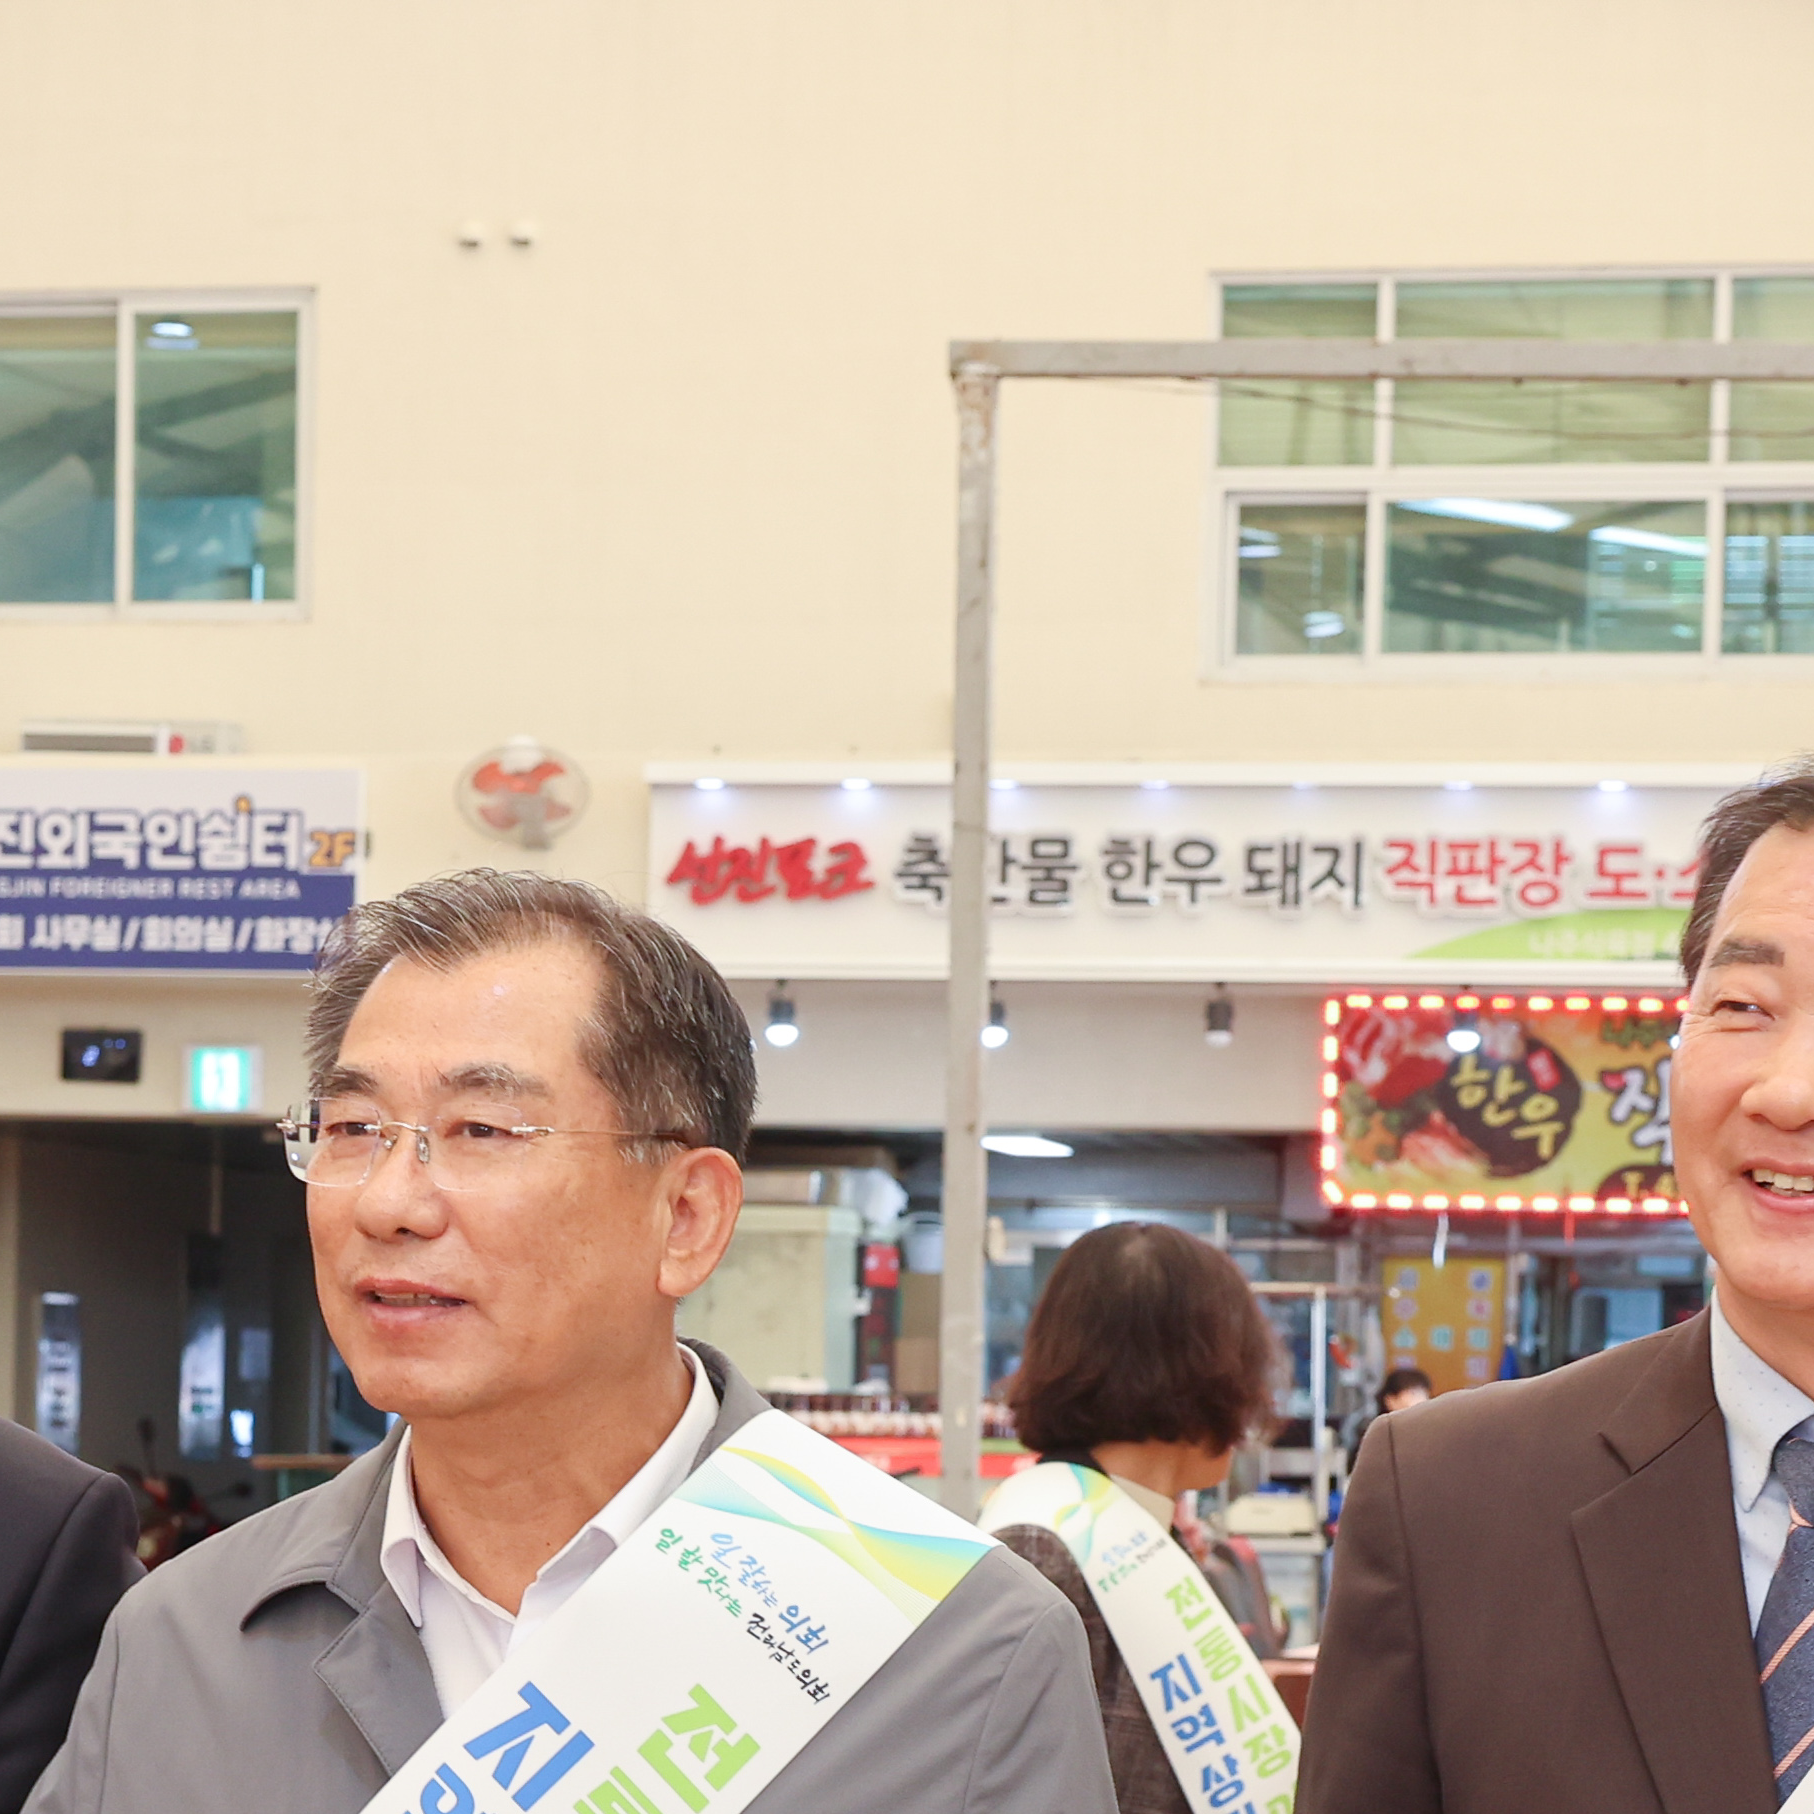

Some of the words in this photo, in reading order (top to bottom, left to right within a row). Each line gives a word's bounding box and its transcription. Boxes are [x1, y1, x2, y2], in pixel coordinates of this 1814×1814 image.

[177, 876, 234, 899] REST
[238, 876, 301, 899] AREA
[308, 830, 356, 868] 2F
[895, 830, 1079, 908] 축물
[1099, 836, 1223, 906] 한우
[1243, 836, 1365, 910] 돼지
[1383, 838, 1573, 908] 직판장
[1450, 1052, 1569, 1162] 한우
[653, 1527, 685, 1555] 일
[745, 1612, 832, 1705] 전라남도의회
[710, 1531, 742, 1570] 일
[778, 1603, 833, 1655] 의회
[1164, 1574, 1293, 1781] 전통시장
